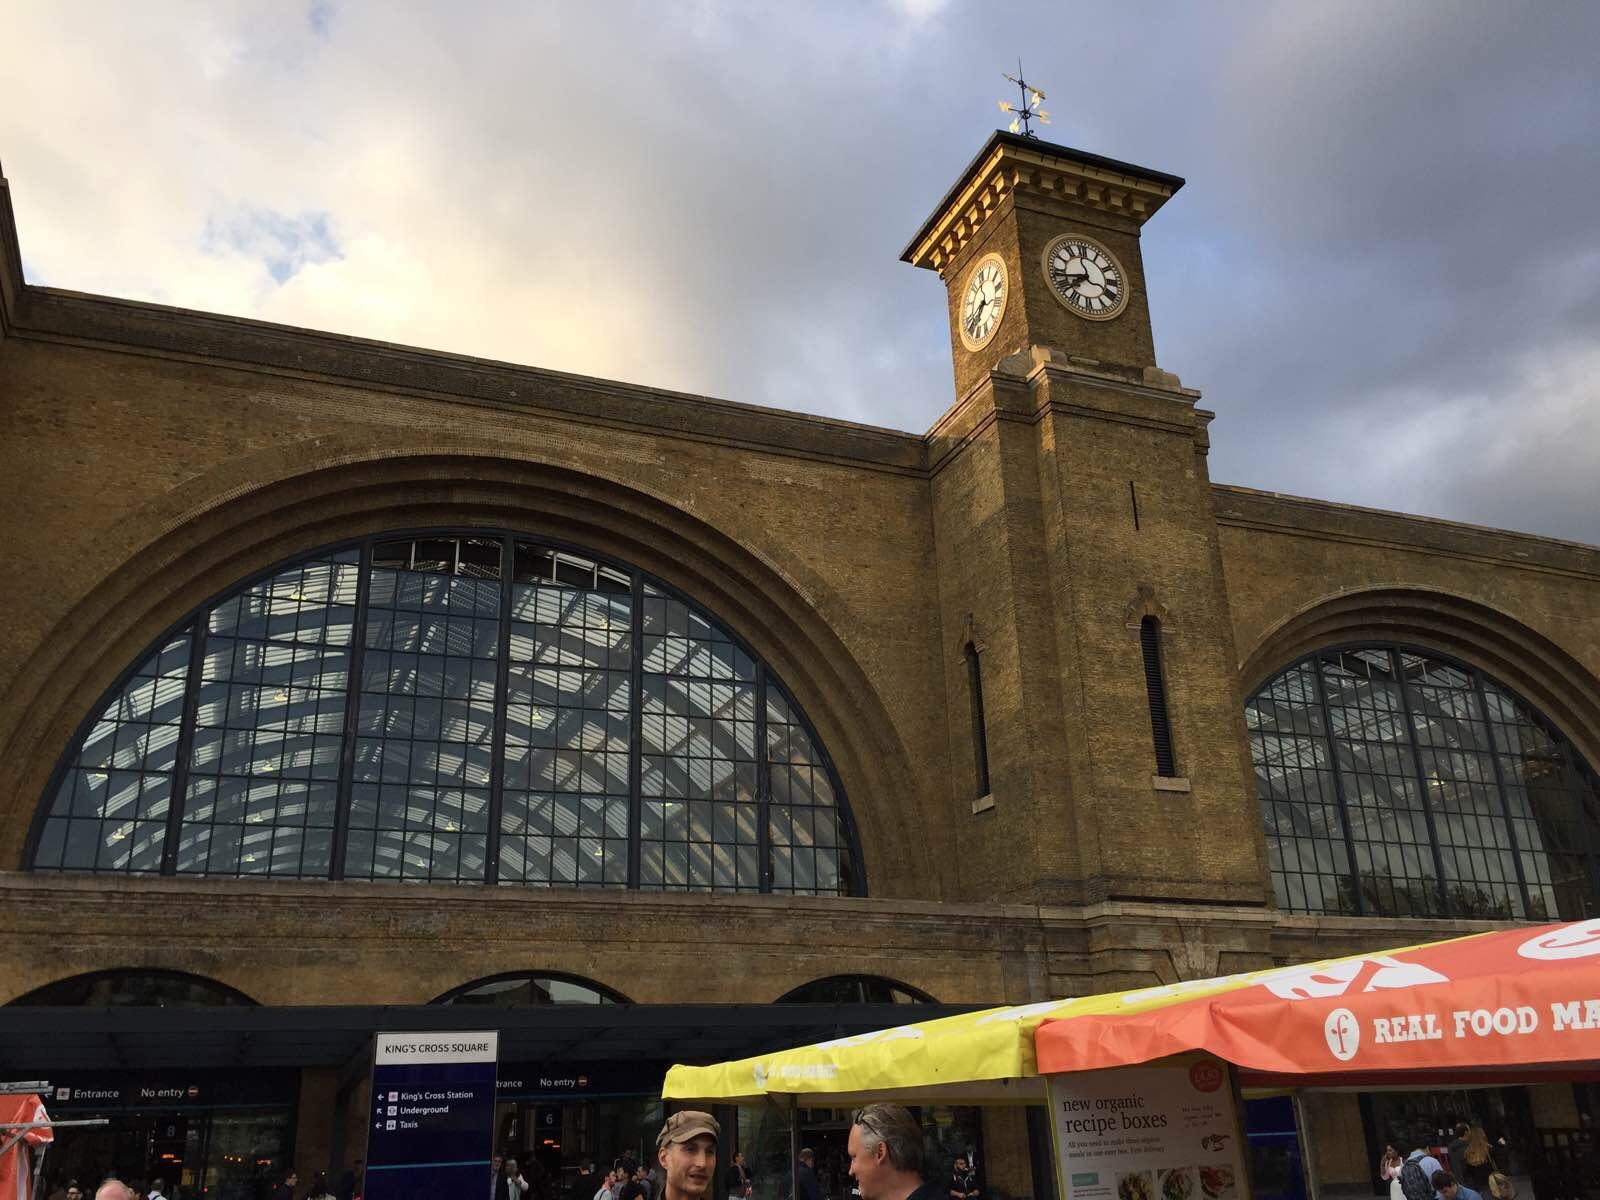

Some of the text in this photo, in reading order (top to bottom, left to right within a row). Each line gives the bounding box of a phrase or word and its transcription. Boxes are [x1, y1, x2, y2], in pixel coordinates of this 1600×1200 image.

[1373, 1014, 1443, 1044] REAL
[1453, 1006, 1539, 1038] FOOD
[385, 1042, 489, 1054] KING'S CROSS SQUARE
[540, 1078, 576, 1089] No entry
[74, 1088, 119, 1099] Entrance
[141, 1088, 185, 1099] No entry
[401, 1091, 474, 1102] King's Cross Station
[1063, 1093, 1144, 1113] new organic
[400, 1105, 449, 1115] Underground
[399, 1120, 418, 1129] Taxis
[546, 1113, 553, 1125] 6
[1065, 1111, 1168, 1136] recipe boxes
[167, 1125, 175, 1137] 8
